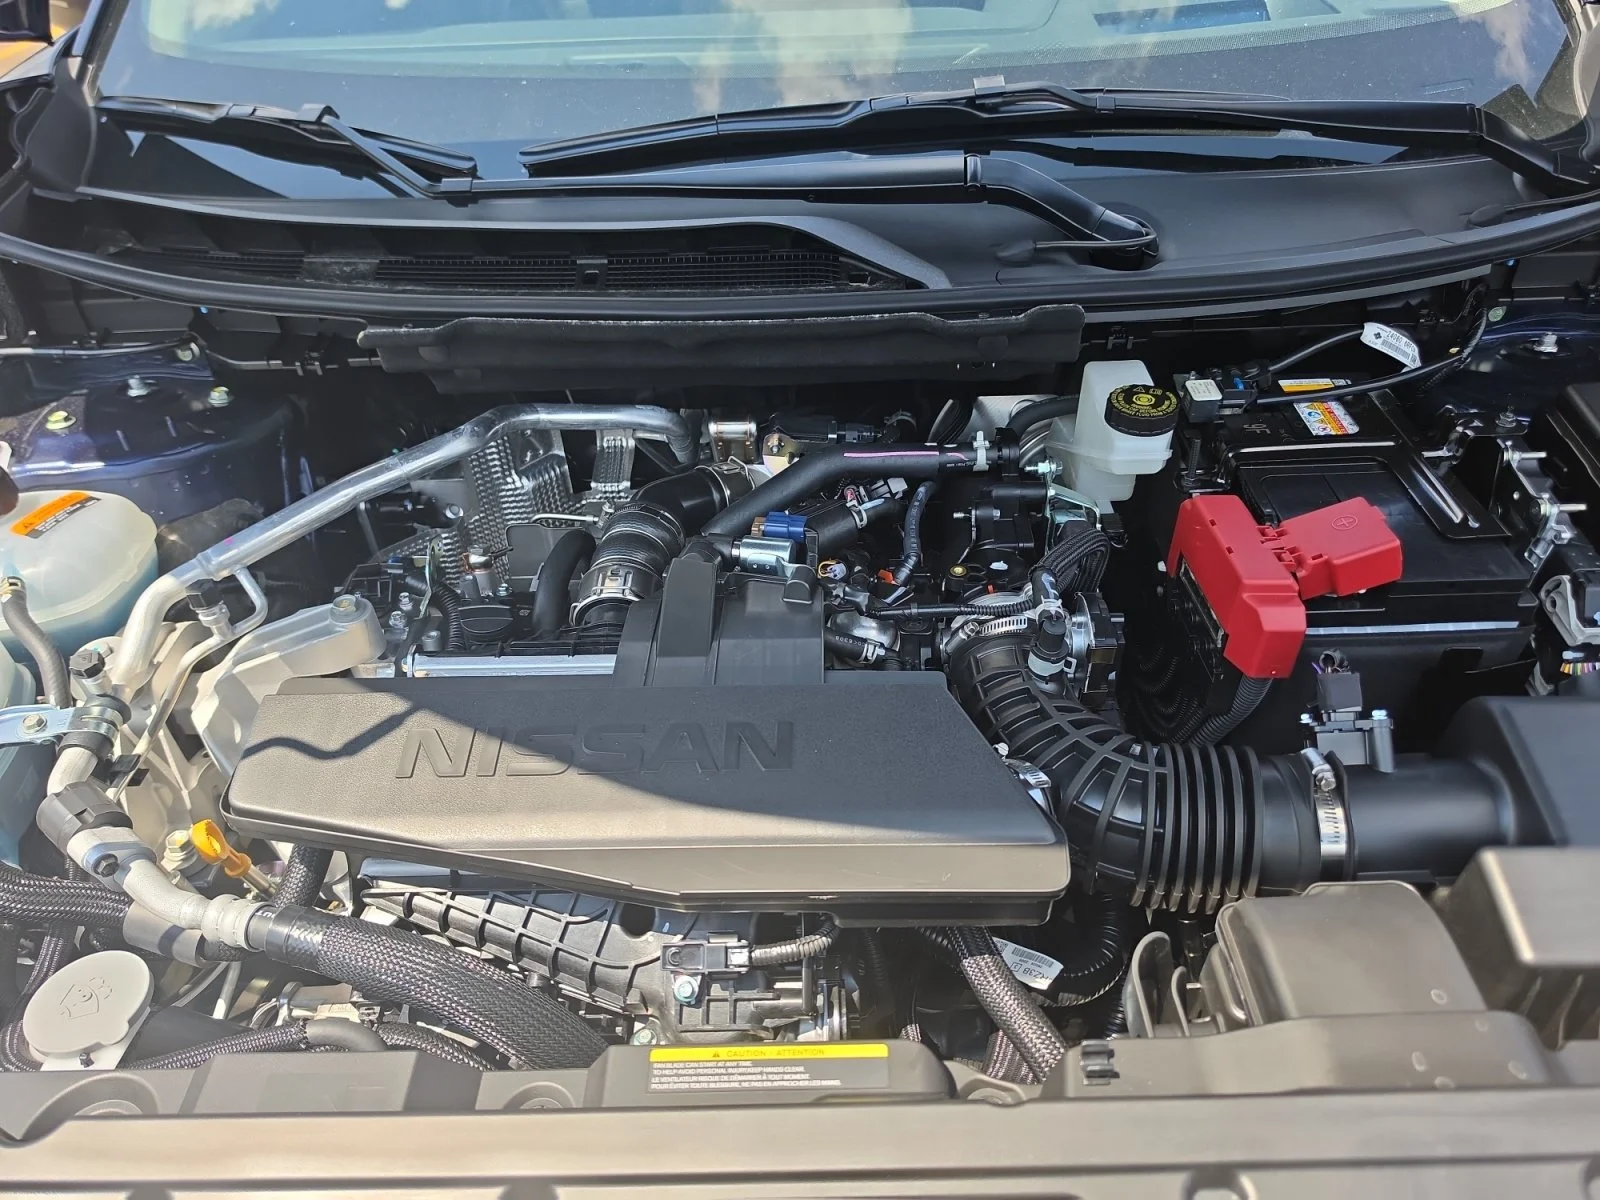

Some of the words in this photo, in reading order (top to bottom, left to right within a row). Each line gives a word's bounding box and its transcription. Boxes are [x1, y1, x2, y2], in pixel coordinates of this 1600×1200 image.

[395, 719, 795, 779] NISSAN
[726, 1050, 766, 1058] CAUTION
[776, 1048, 824, 1057] ATTENTION
